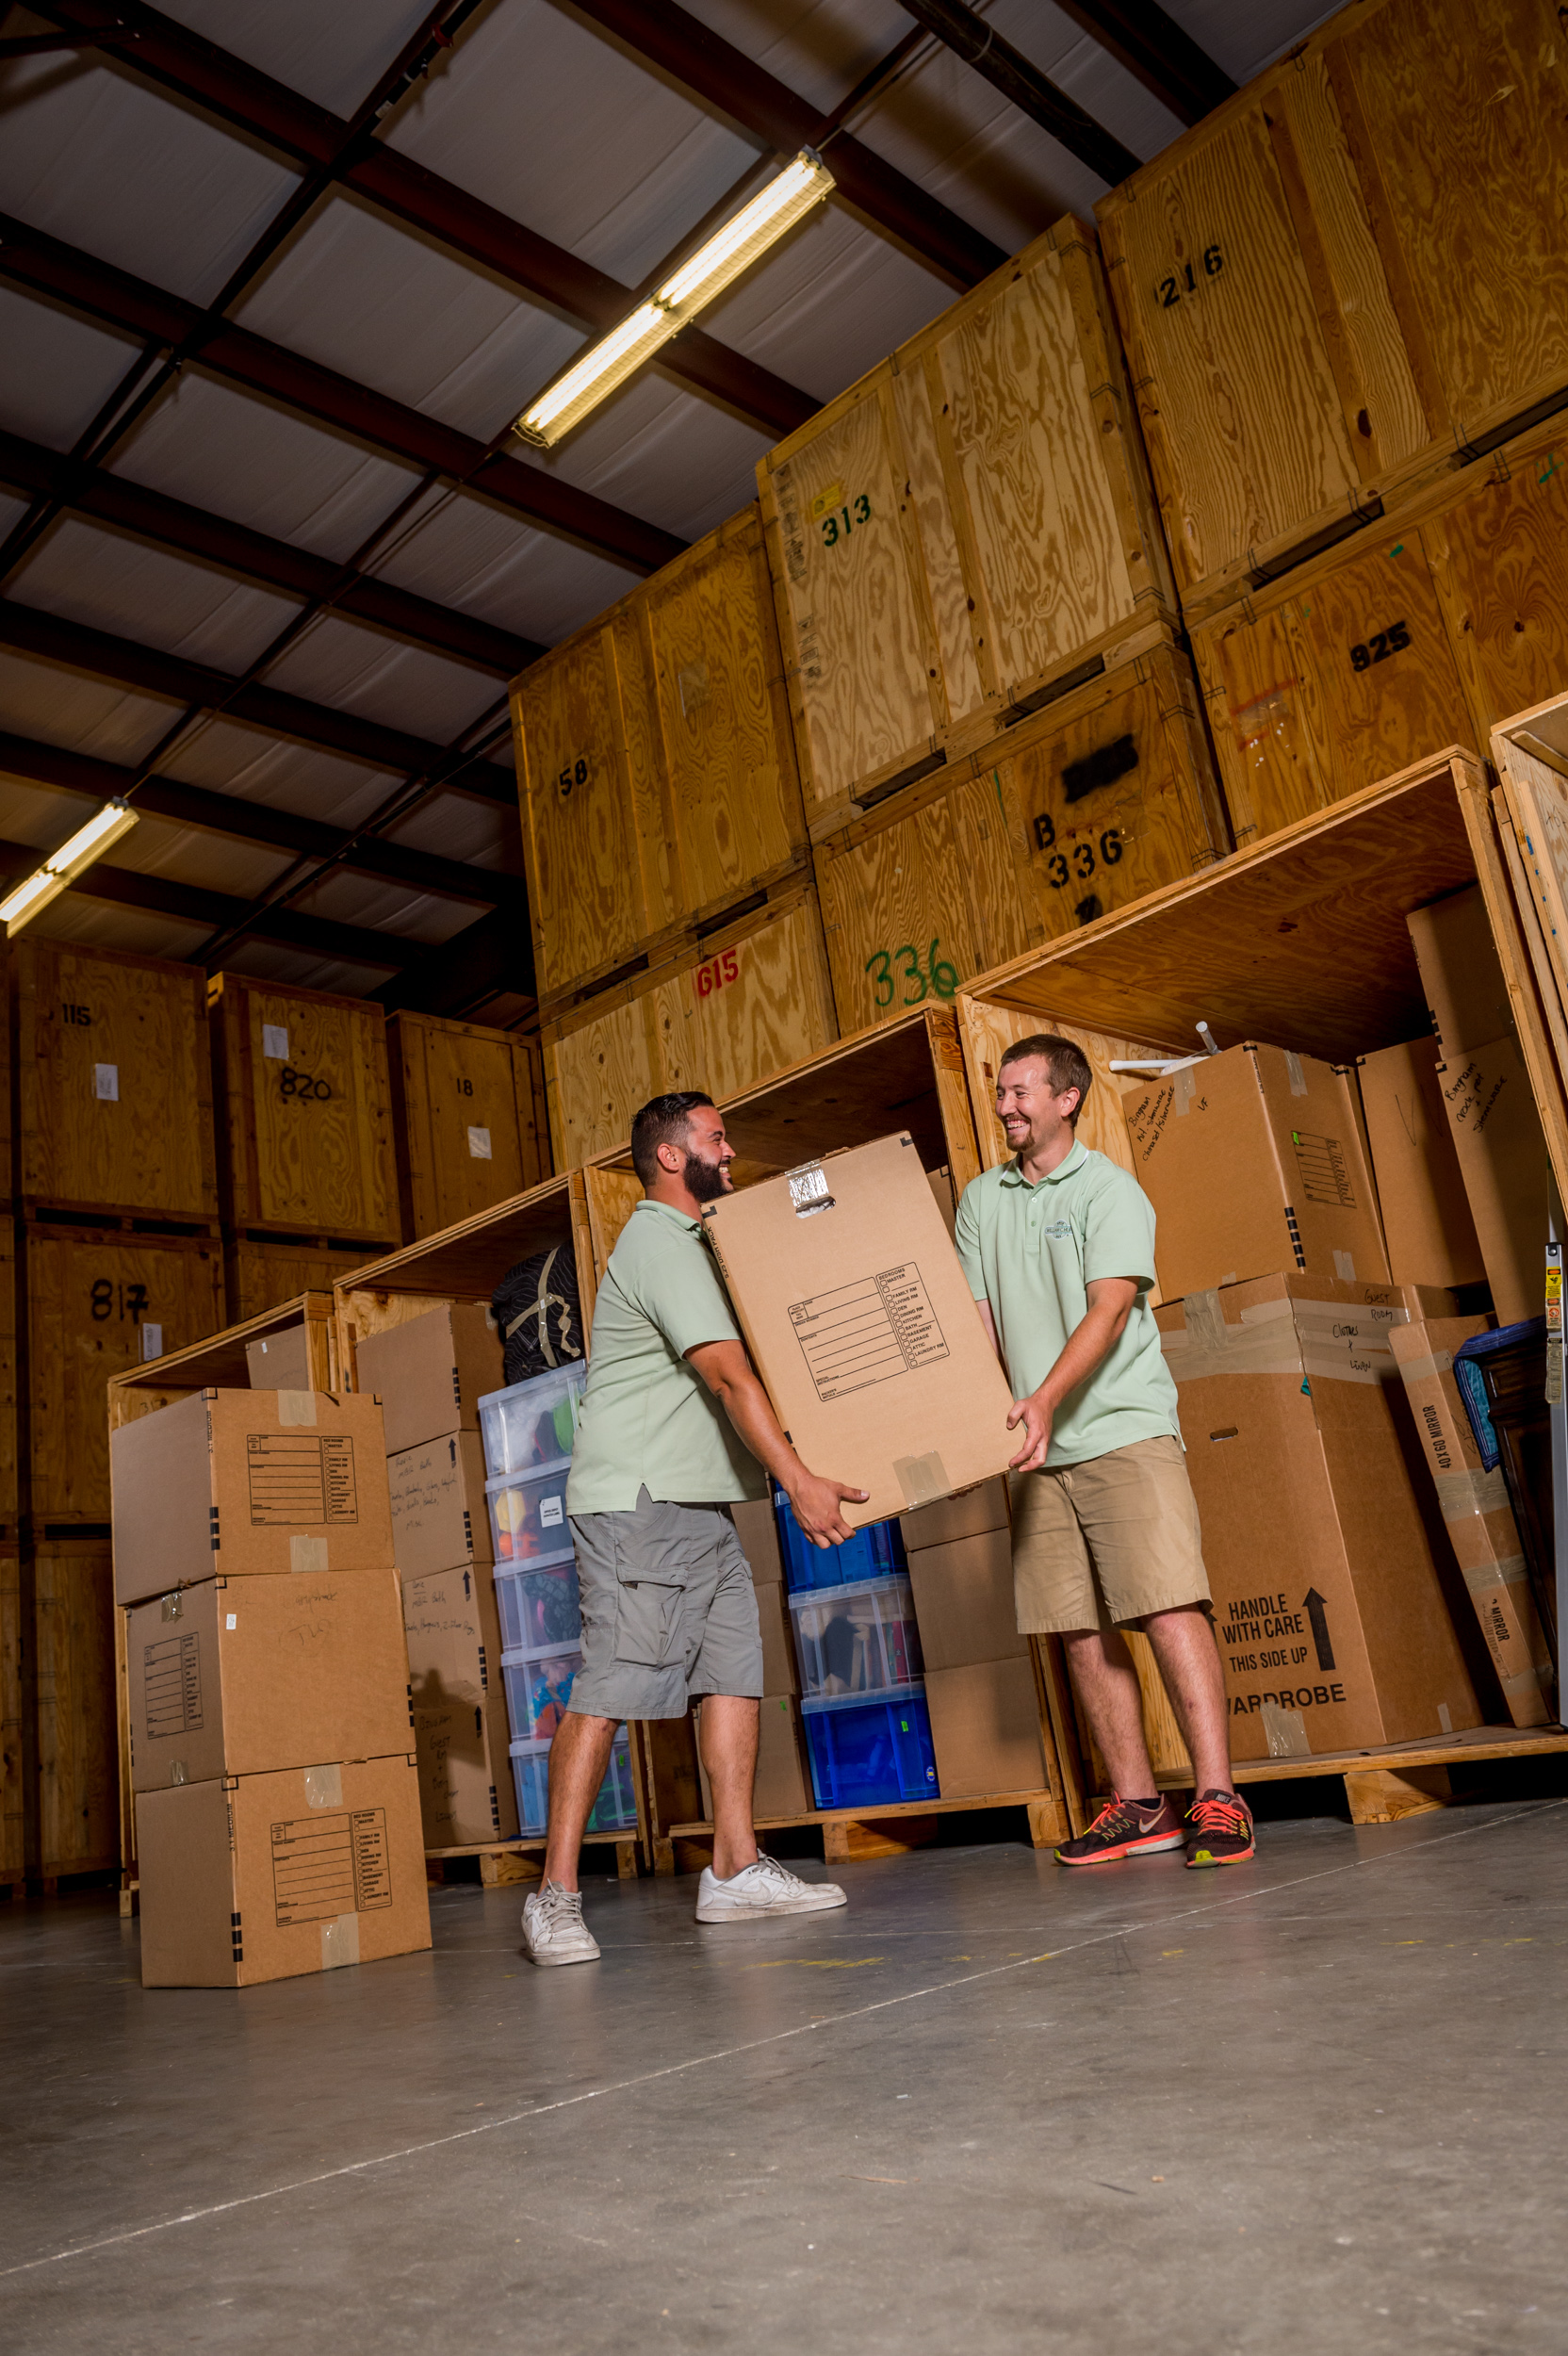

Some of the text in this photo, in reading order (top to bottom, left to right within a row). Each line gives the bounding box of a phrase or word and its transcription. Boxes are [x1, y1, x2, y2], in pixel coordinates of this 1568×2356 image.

[1160, 245, 1222, 307] 216
[822, 494, 871, 547] 313
[1350, 620, 1411, 672] 925
[560, 759, 588, 796] 58
[1033, 813, 1055, 851] B
[1048, 829, 1123, 889] 336
[696, 949, 740, 998] 615
[865, 938, 962, 1006] 336
[62, 1003, 91, 1026] 115
[280, 1067, 332, 1101] 820
[457, 1077, 473, 1097] 18
[887, 1274, 906, 1283] MASTER
[892, 1289, 908, 1298] FAMILY
[90, 1278, 149, 1325] 817
[900, 1309, 915, 1317] DINING
[903, 1315, 923, 1324] KITCHEN
[907, 1325, 932, 1336] BASEMENT
[910, 1333, 929, 1343] GARAGE
[915, 1346, 936, 1356] LAUNDRY
[1422, 1404, 1443, 1439] MIRROR
[1228, 1593, 1288, 1622] HANDLE
[1221, 1613, 1304, 1644] WITH CARE
[1492, 1606, 1510, 1642] MIRROR
[1229, 1646, 1308, 1673] THIS SIDE UP
[1226, 1683, 1348, 1715] ARDROBE
